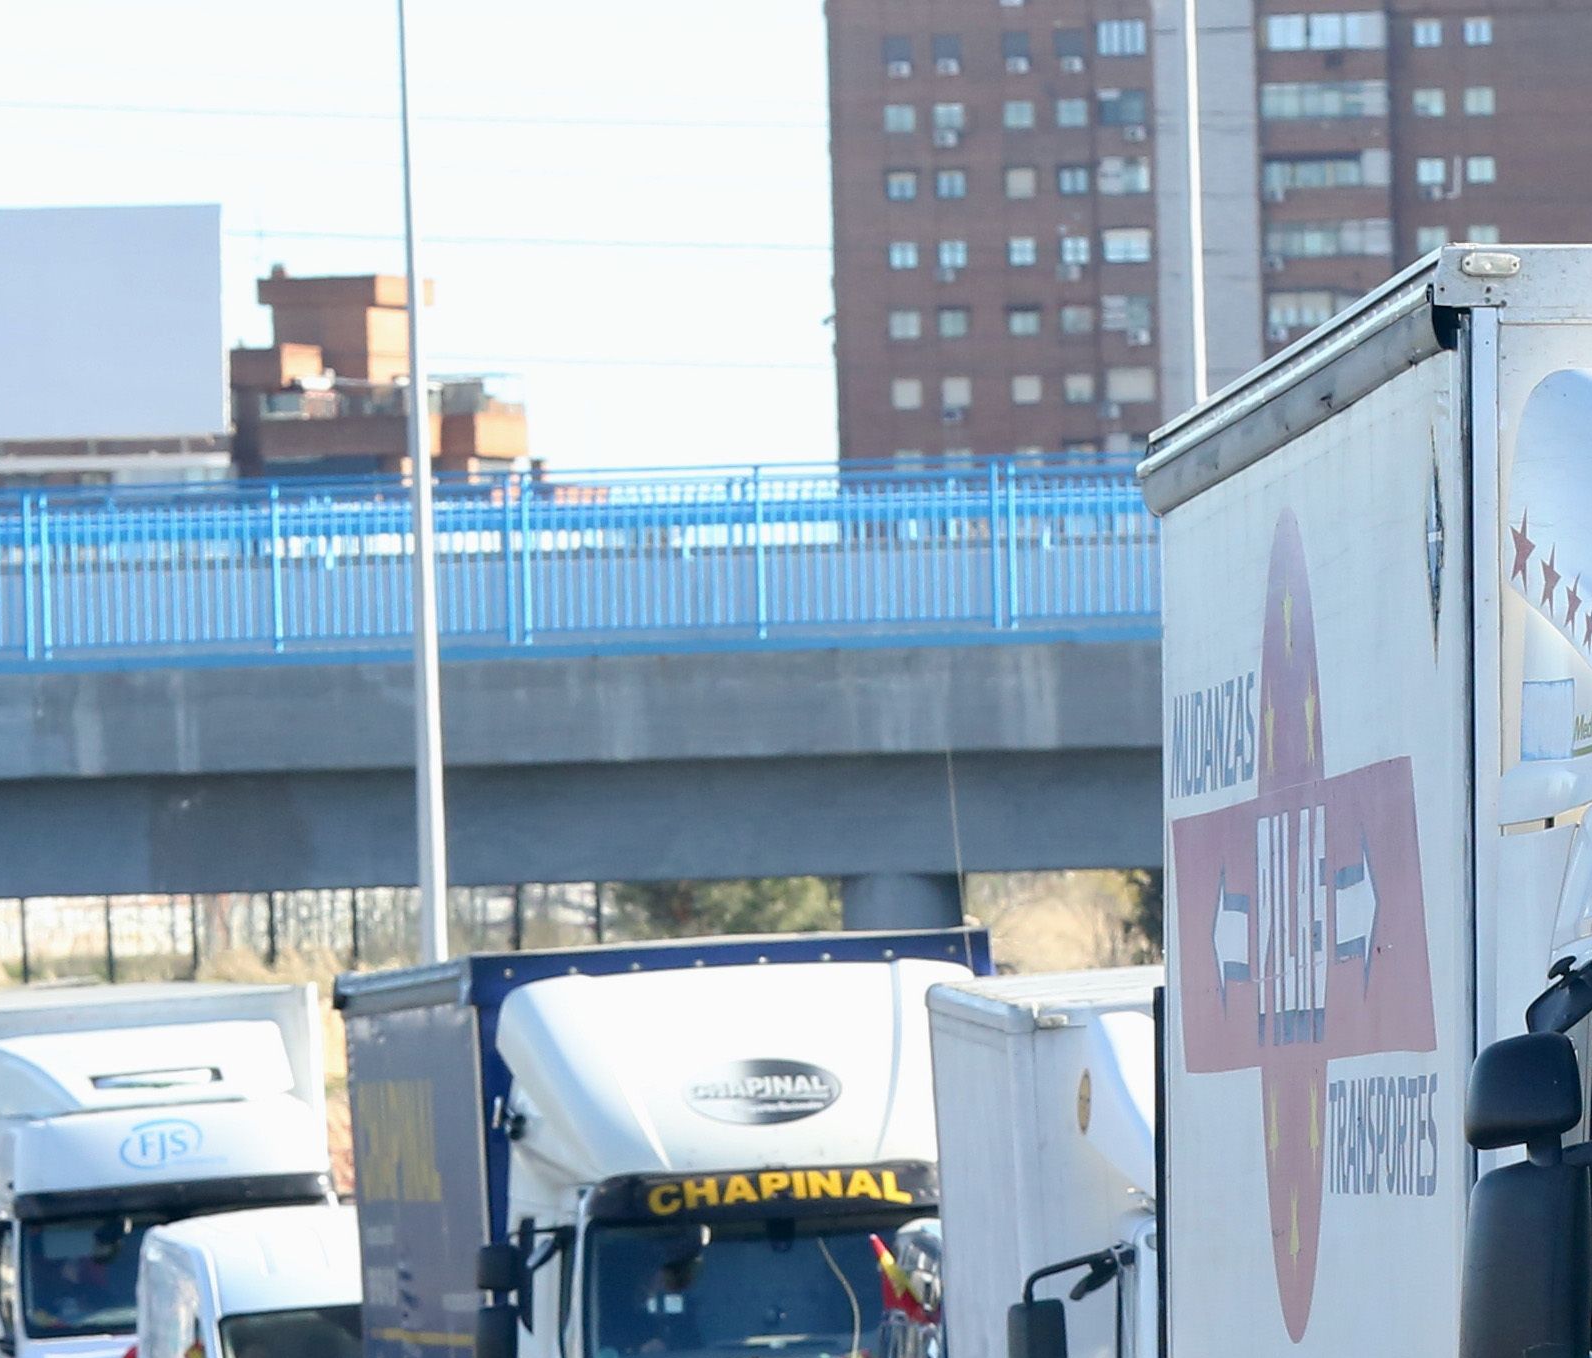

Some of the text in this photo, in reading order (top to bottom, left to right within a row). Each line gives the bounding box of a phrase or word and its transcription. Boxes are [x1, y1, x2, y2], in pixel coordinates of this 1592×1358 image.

[1171, 671, 1255, 799] MUDANZAS
[1257, 804, 1328, 1044] PILAS
[691, 1073, 829, 1099] CHAPINAL
[140, 1130, 187, 1168] FJS
[1329, 1072, 1438, 1197] TRANSPORTES
[648, 1168, 913, 1216] CHAPINAL
